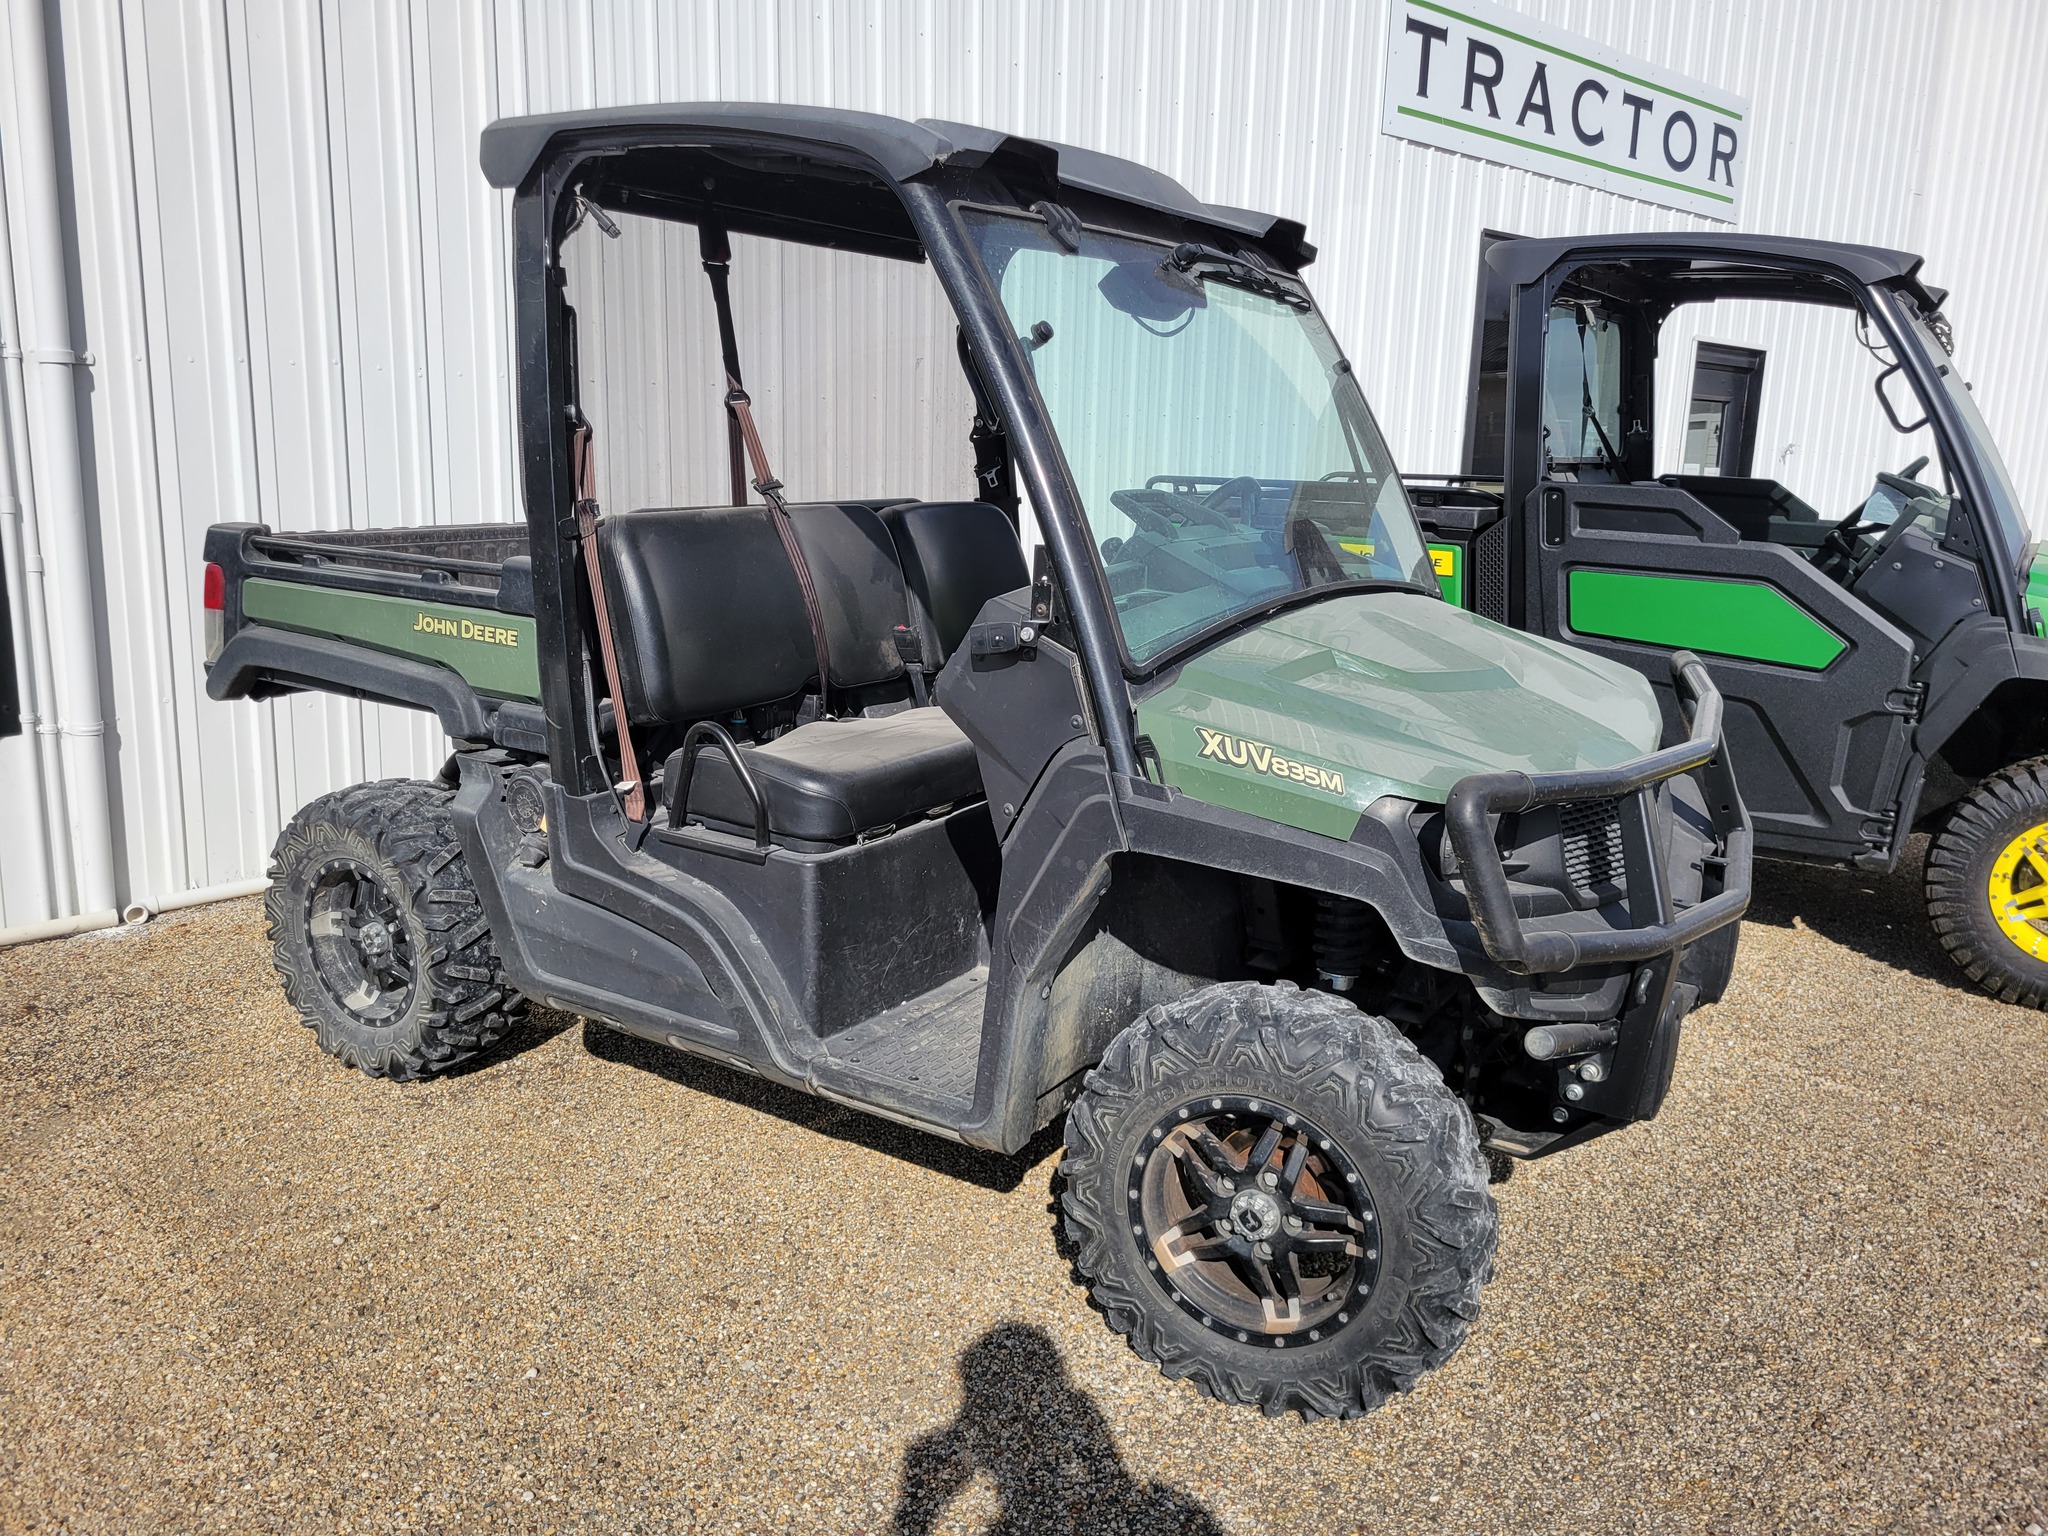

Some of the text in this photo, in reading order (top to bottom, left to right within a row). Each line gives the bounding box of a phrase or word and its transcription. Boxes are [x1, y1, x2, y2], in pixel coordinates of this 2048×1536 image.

[1405, 13, 1738, 188] TRACTOR
[413, 612, 518, 647] JOHN DEERE
[1196, 727, 1344, 795] XUV835M
